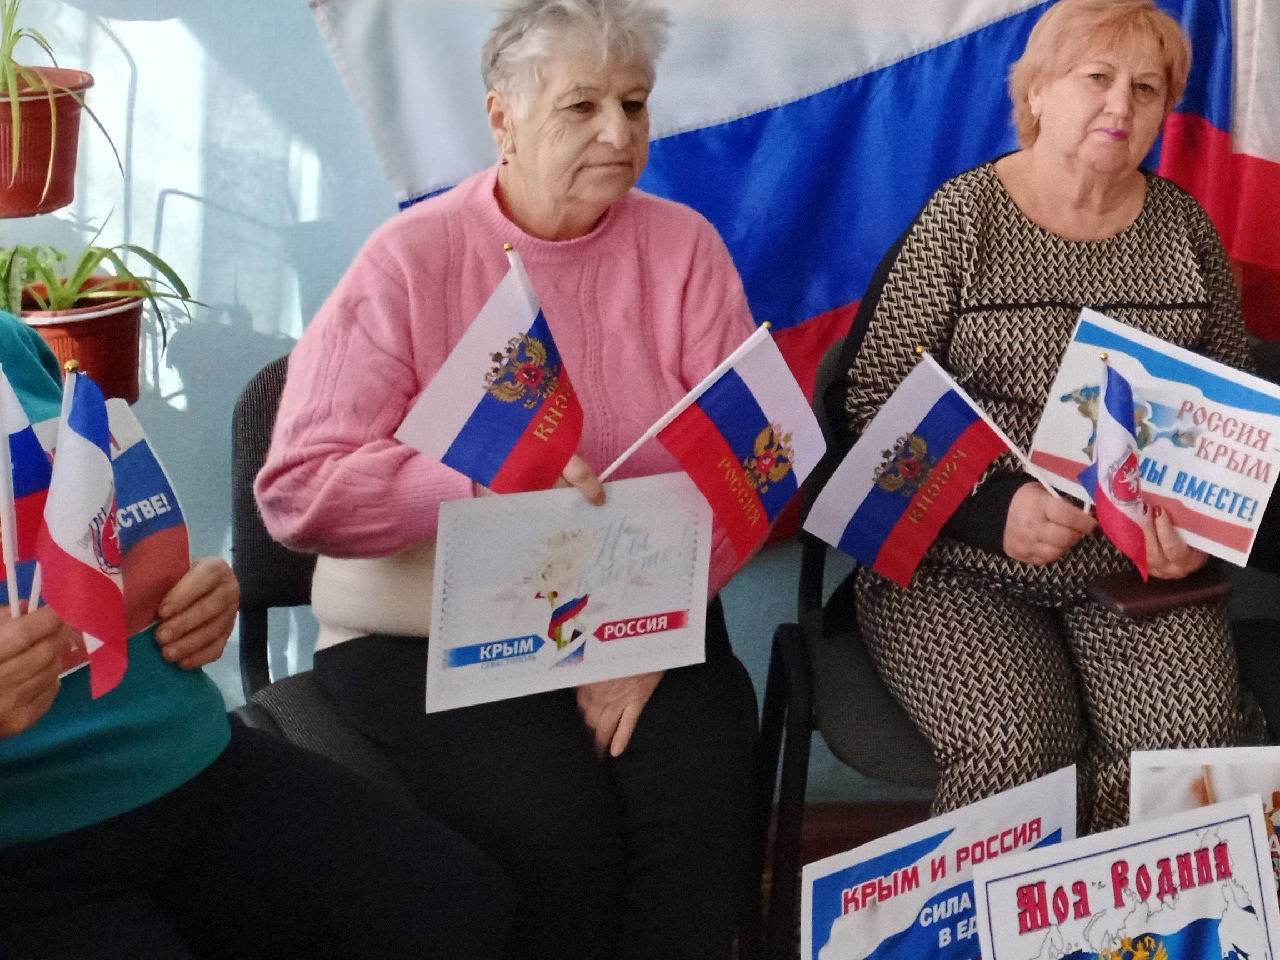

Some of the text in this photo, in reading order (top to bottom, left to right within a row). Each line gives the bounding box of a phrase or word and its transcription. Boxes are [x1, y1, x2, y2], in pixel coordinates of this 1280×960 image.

[1177, 400, 1272, 452] РОССИЯ
[1195, 437, 1273, 484] КРЫМ
[117, 493, 172, 528] СТВЕ!
[718, 457, 761, 527] РОССИЯ
[1172, 470, 1259, 522] ВМЕСТЕ!
[479, 637, 534, 660] КРЫМ
[603, 615, 668, 639] РОССИЯ
[843, 817, 1042, 915] КРЫМ И РОССИЯ
[919, 892, 971, 927] СИЛА
[1016, 880, 1091, 936] Моя
[938, 916, 978, 949] В ЕД
